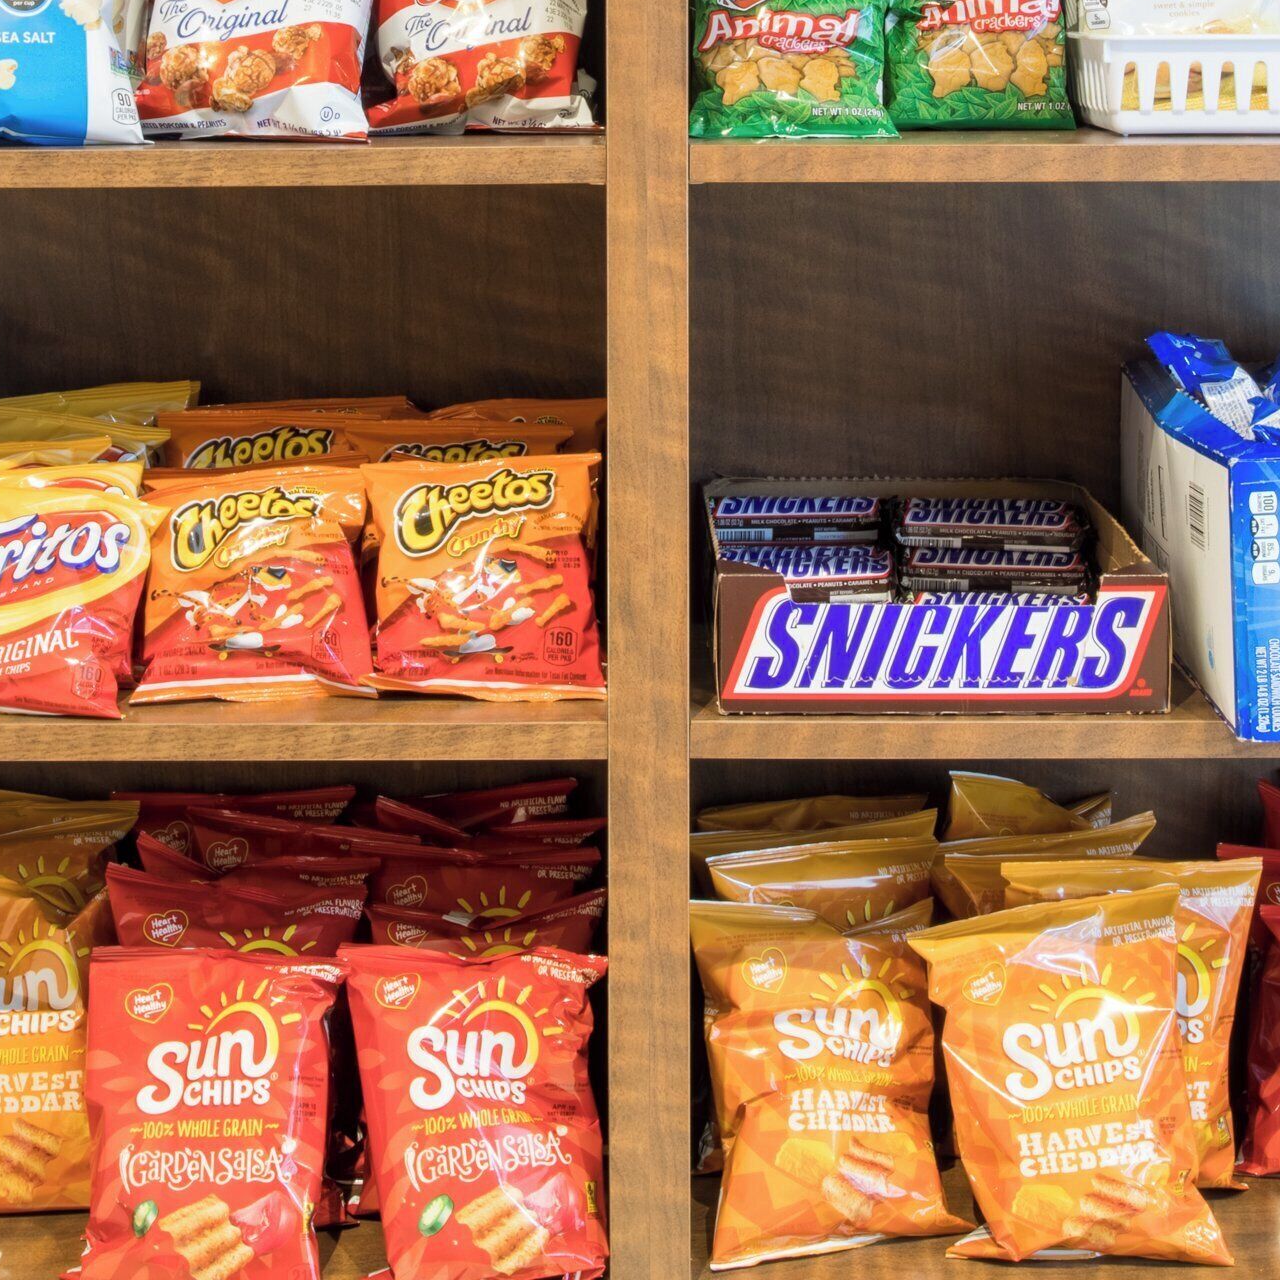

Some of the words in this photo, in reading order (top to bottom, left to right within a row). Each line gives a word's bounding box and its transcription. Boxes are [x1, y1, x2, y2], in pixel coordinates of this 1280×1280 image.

[22, 31, 56, 43] SALT
[701, 10, 860, 51] Animal
[760, 34, 827, 53] crackers
[396, 467, 556, 555] Cheetos
[744, 596, 1145, 690] SNICKERS
[32, 1046, 69, 1062] GRAIN
[136, 1029, 277, 1115] Sun
[1002, 1016, 1139, 1101] Sun
[183, 1074, 271, 1106] CHIPS
[1053, 1056, 1142, 1091] CHIPS
[1018, 1119, 1154, 1157] HARVEST
